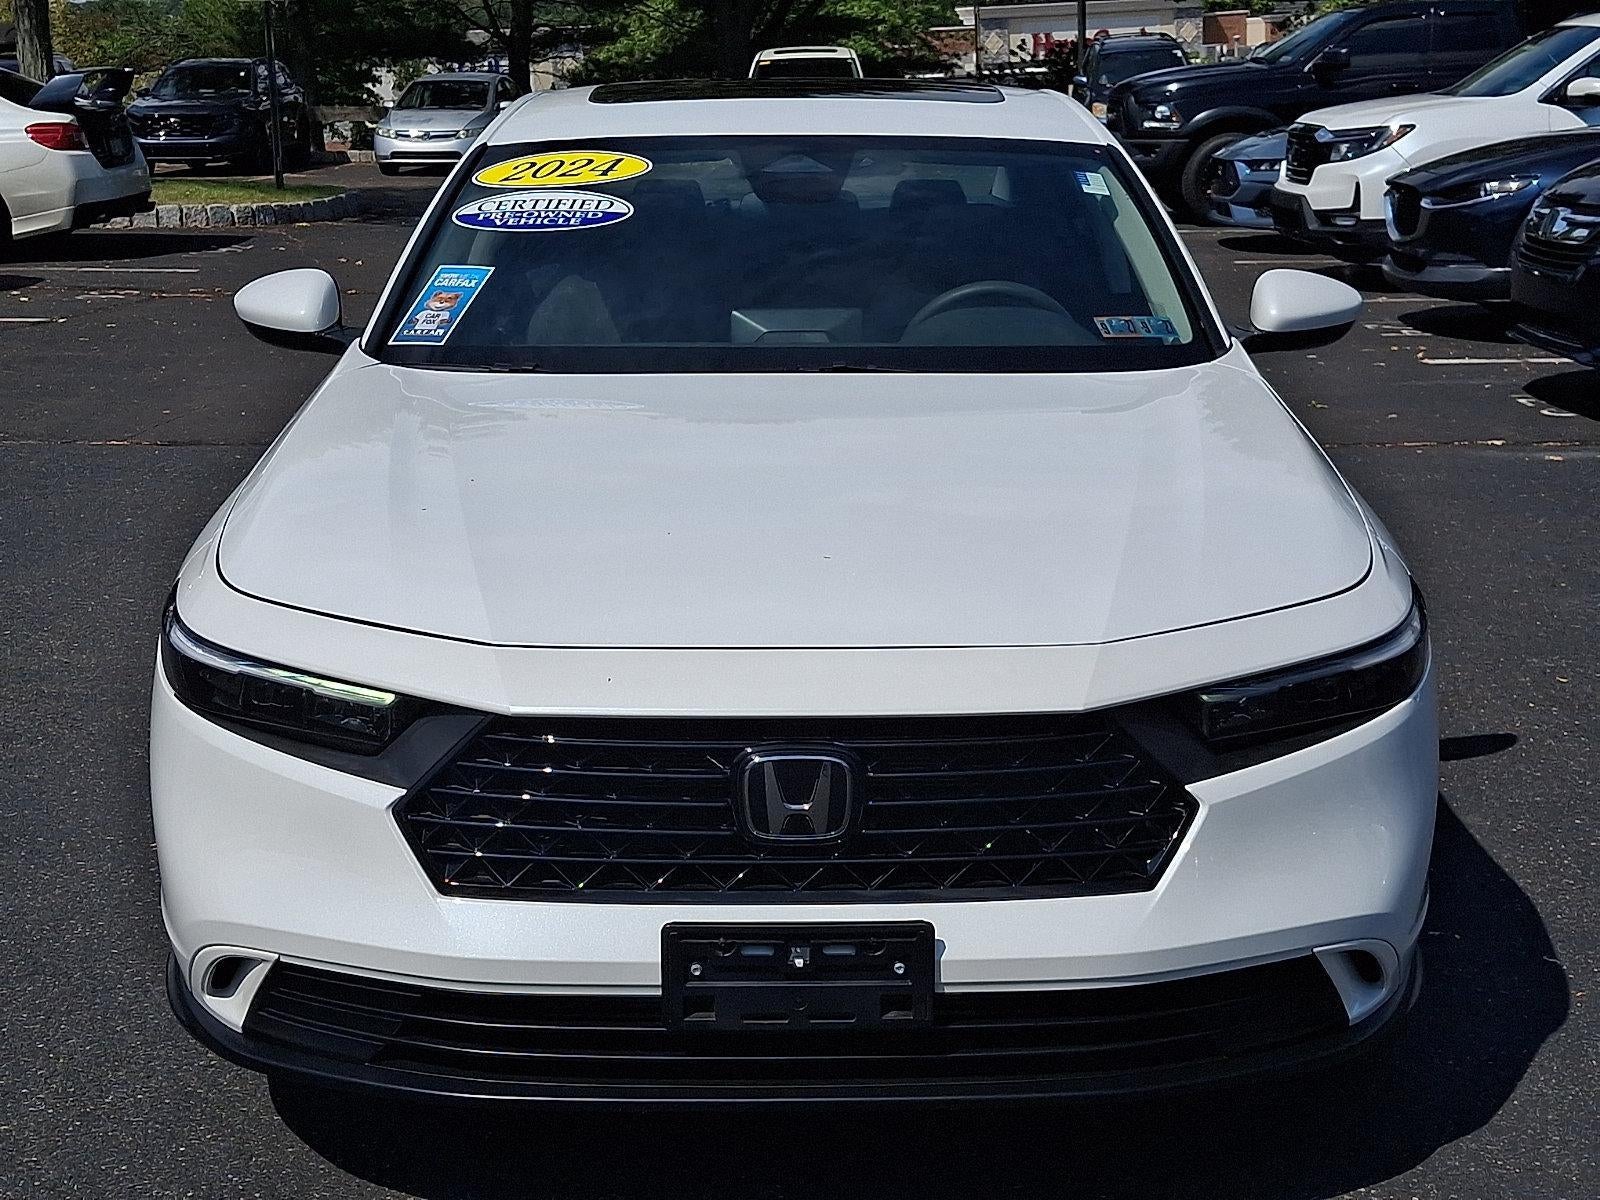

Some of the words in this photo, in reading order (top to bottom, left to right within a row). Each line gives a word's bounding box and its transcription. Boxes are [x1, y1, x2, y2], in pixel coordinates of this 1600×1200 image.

[498, 157, 625, 182] 2024
[477, 198, 615, 212] CERTIFIED
[477, 210, 603, 220] PRE-OWNED
[493, 216, 582, 226] VEHICLE
[434, 279, 478, 287] CARFAX
